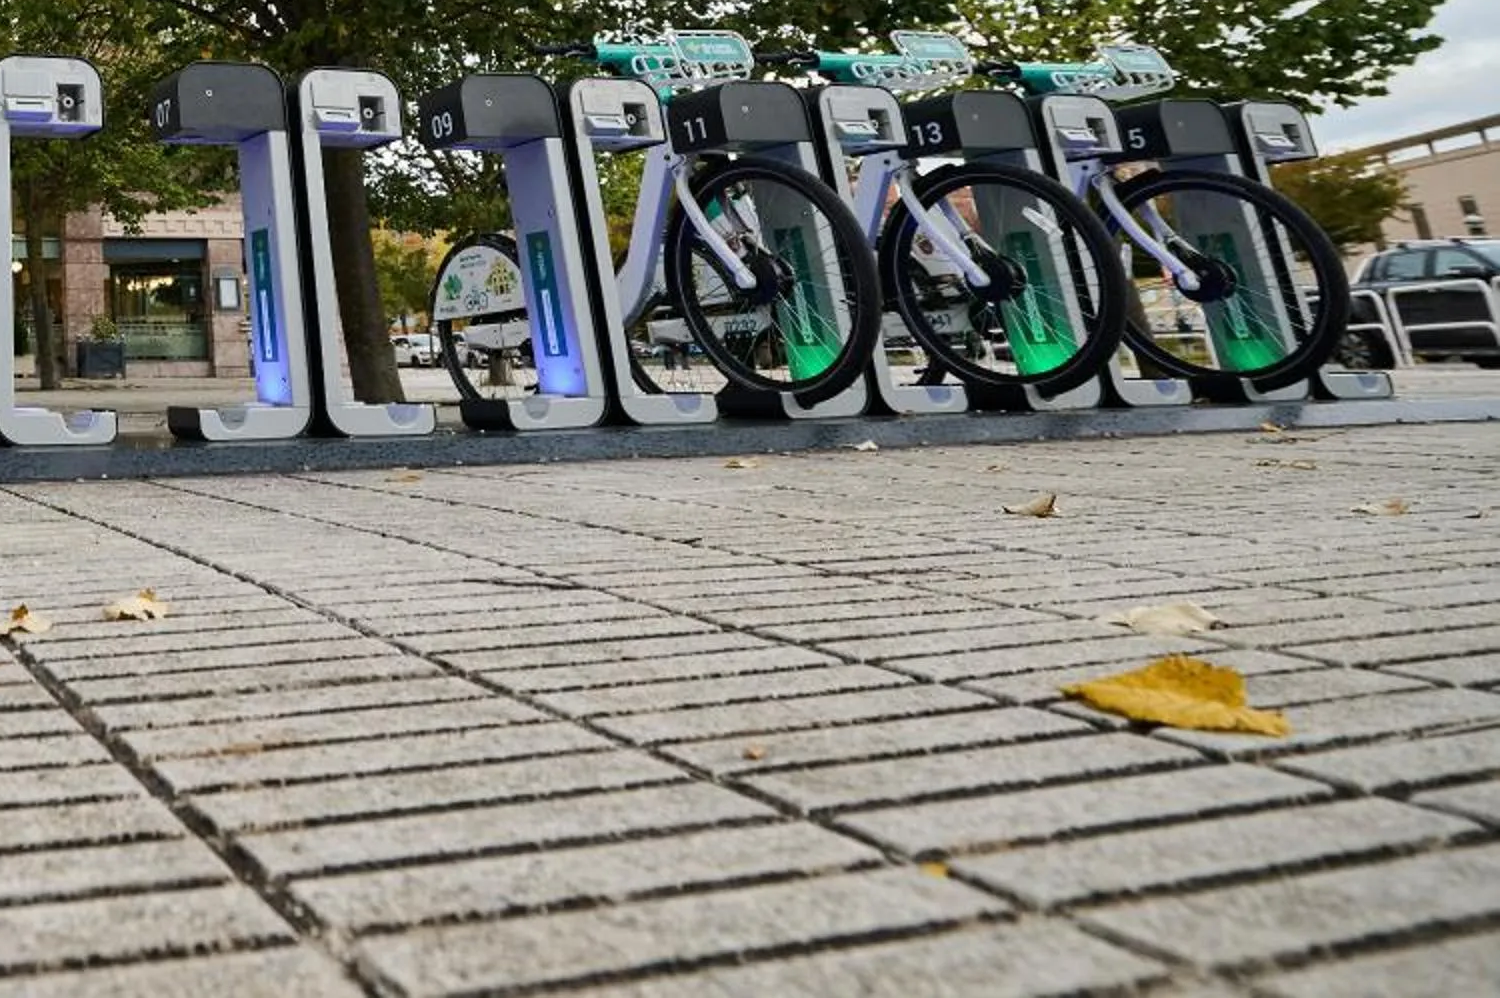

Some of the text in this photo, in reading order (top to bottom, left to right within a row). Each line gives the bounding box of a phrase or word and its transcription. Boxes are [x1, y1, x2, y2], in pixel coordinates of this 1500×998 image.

[155, 98, 171, 128] 07
[431, 111, 453, 139] 09
[683, 117, 707, 143] 11
[911, 121, 944, 147] 13
